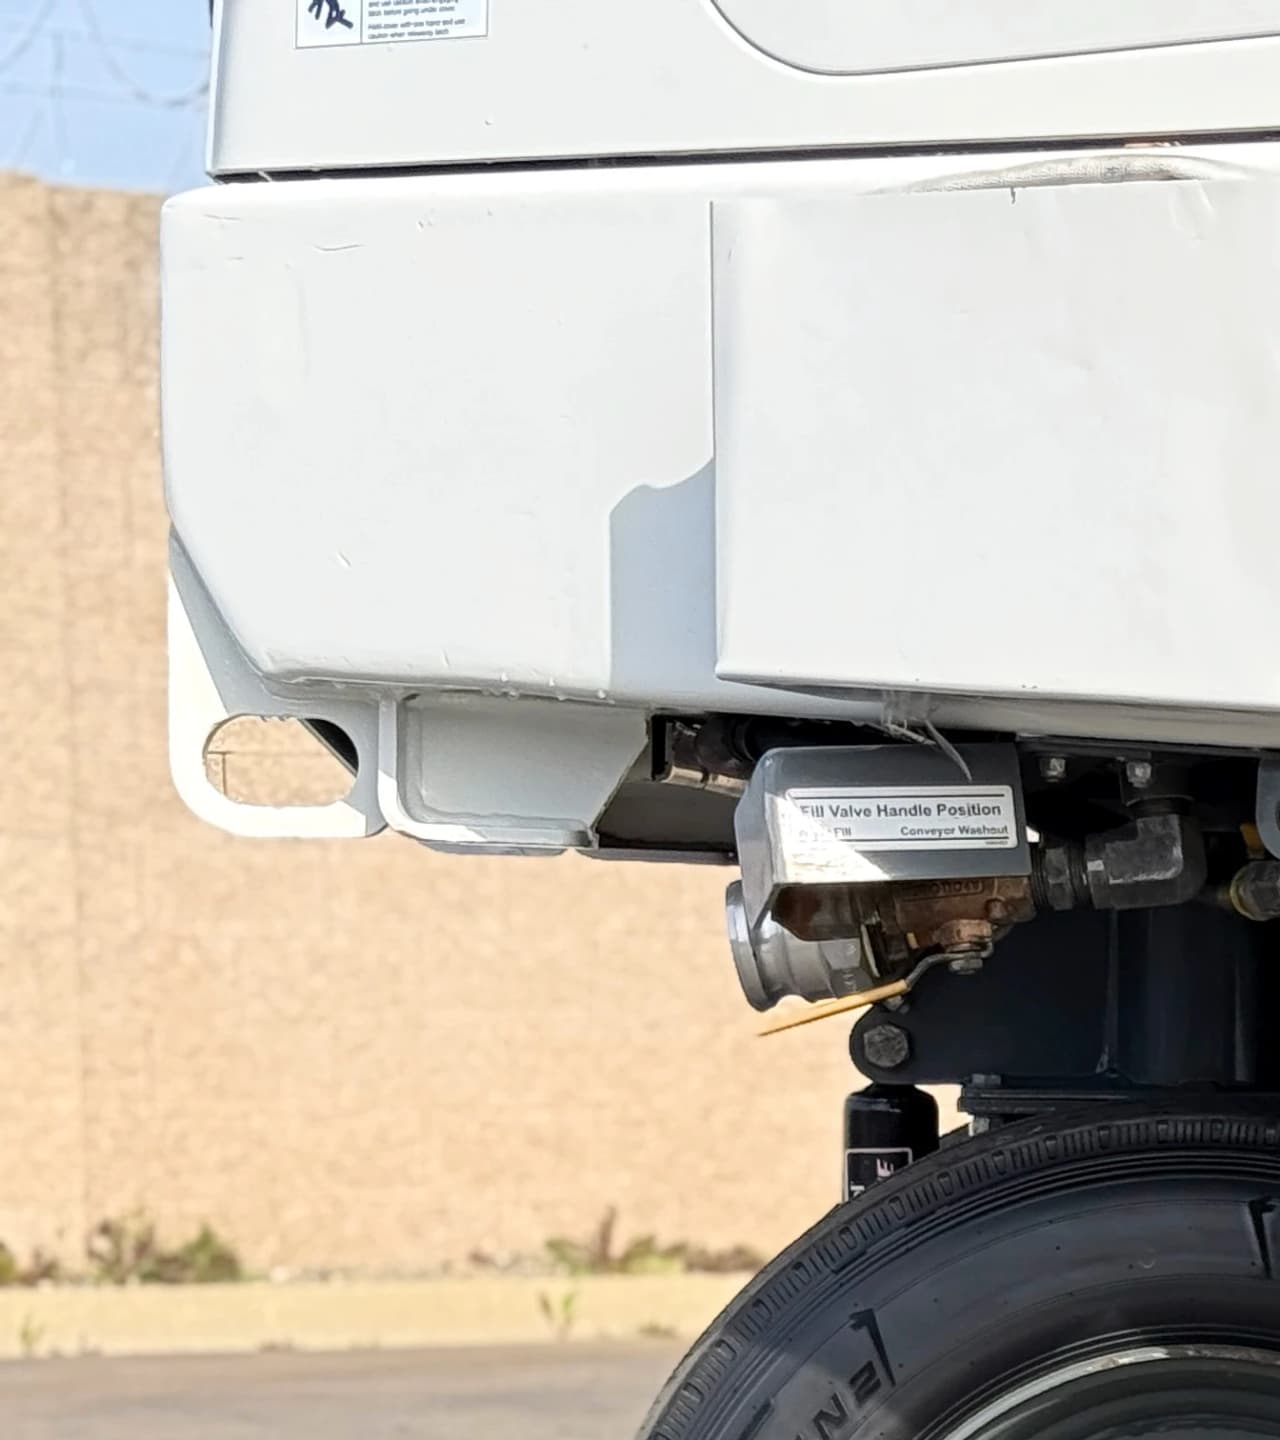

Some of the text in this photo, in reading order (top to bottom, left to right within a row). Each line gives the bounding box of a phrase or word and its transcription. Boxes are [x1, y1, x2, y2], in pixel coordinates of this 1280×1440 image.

[800, 802, 1002, 818] Fill Valve Handle Position
[900, 825, 955, 839] Conveyor
[958, 825, 1009, 837] Washout
